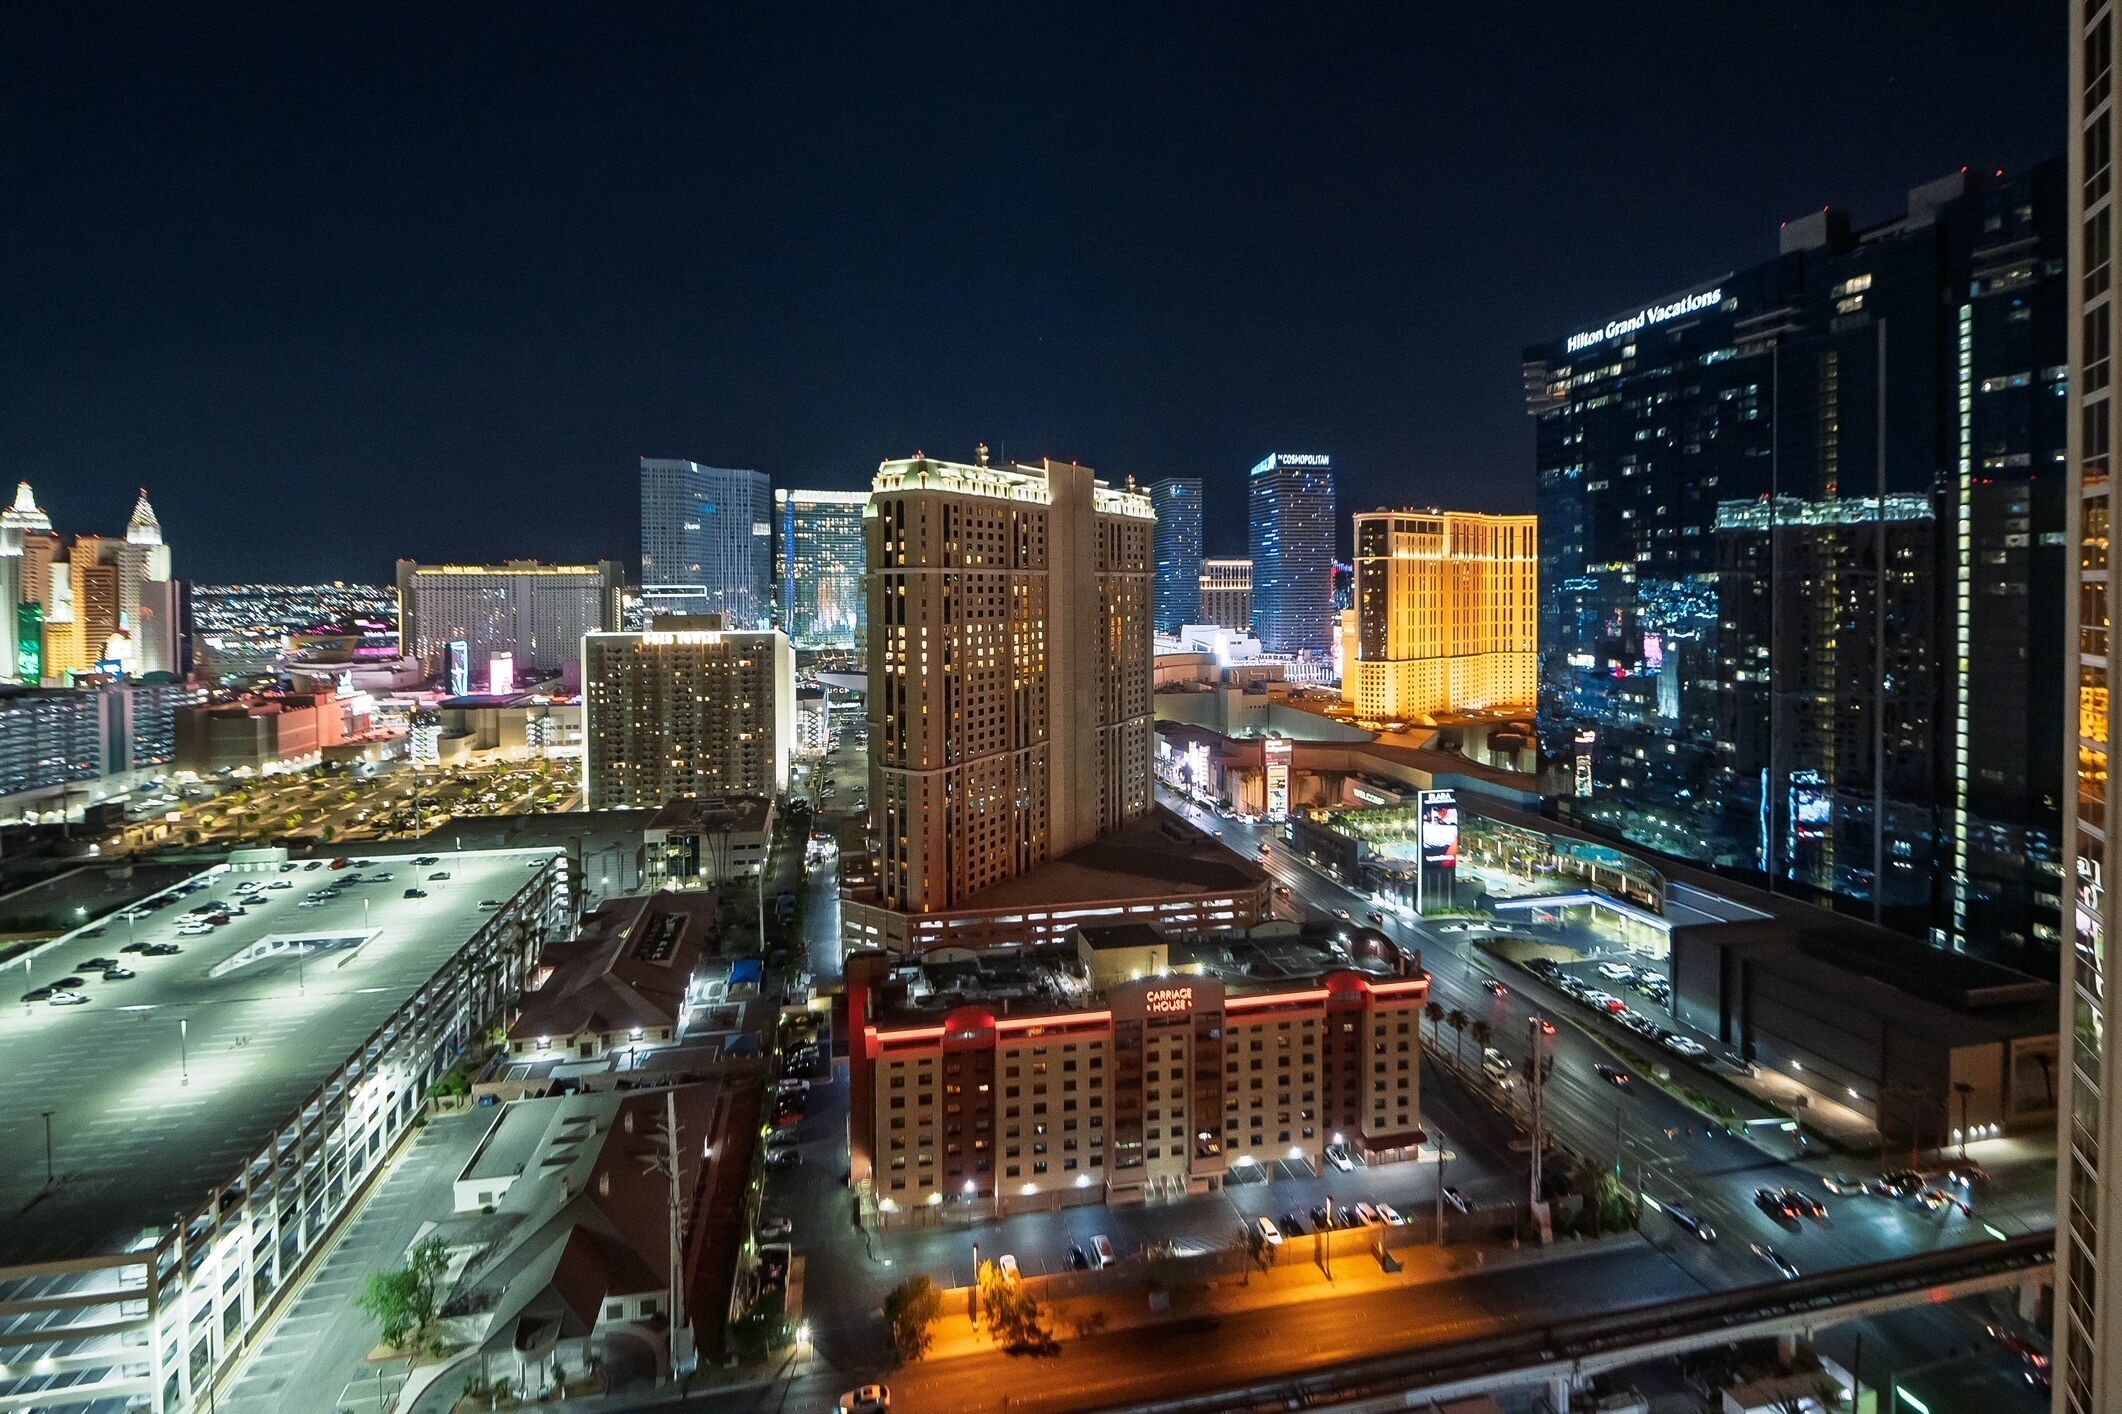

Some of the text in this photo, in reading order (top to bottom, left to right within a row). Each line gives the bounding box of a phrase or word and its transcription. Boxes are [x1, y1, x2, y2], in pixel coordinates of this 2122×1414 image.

[1567, 288, 1721, 353] Hilton Grand Vacations
[1283, 454, 1330, 465] COSMOPOLITAN
[1146, 987, 1192, 1002] CARRIAGE
[1152, 999, 1186, 1013] HOUSE
